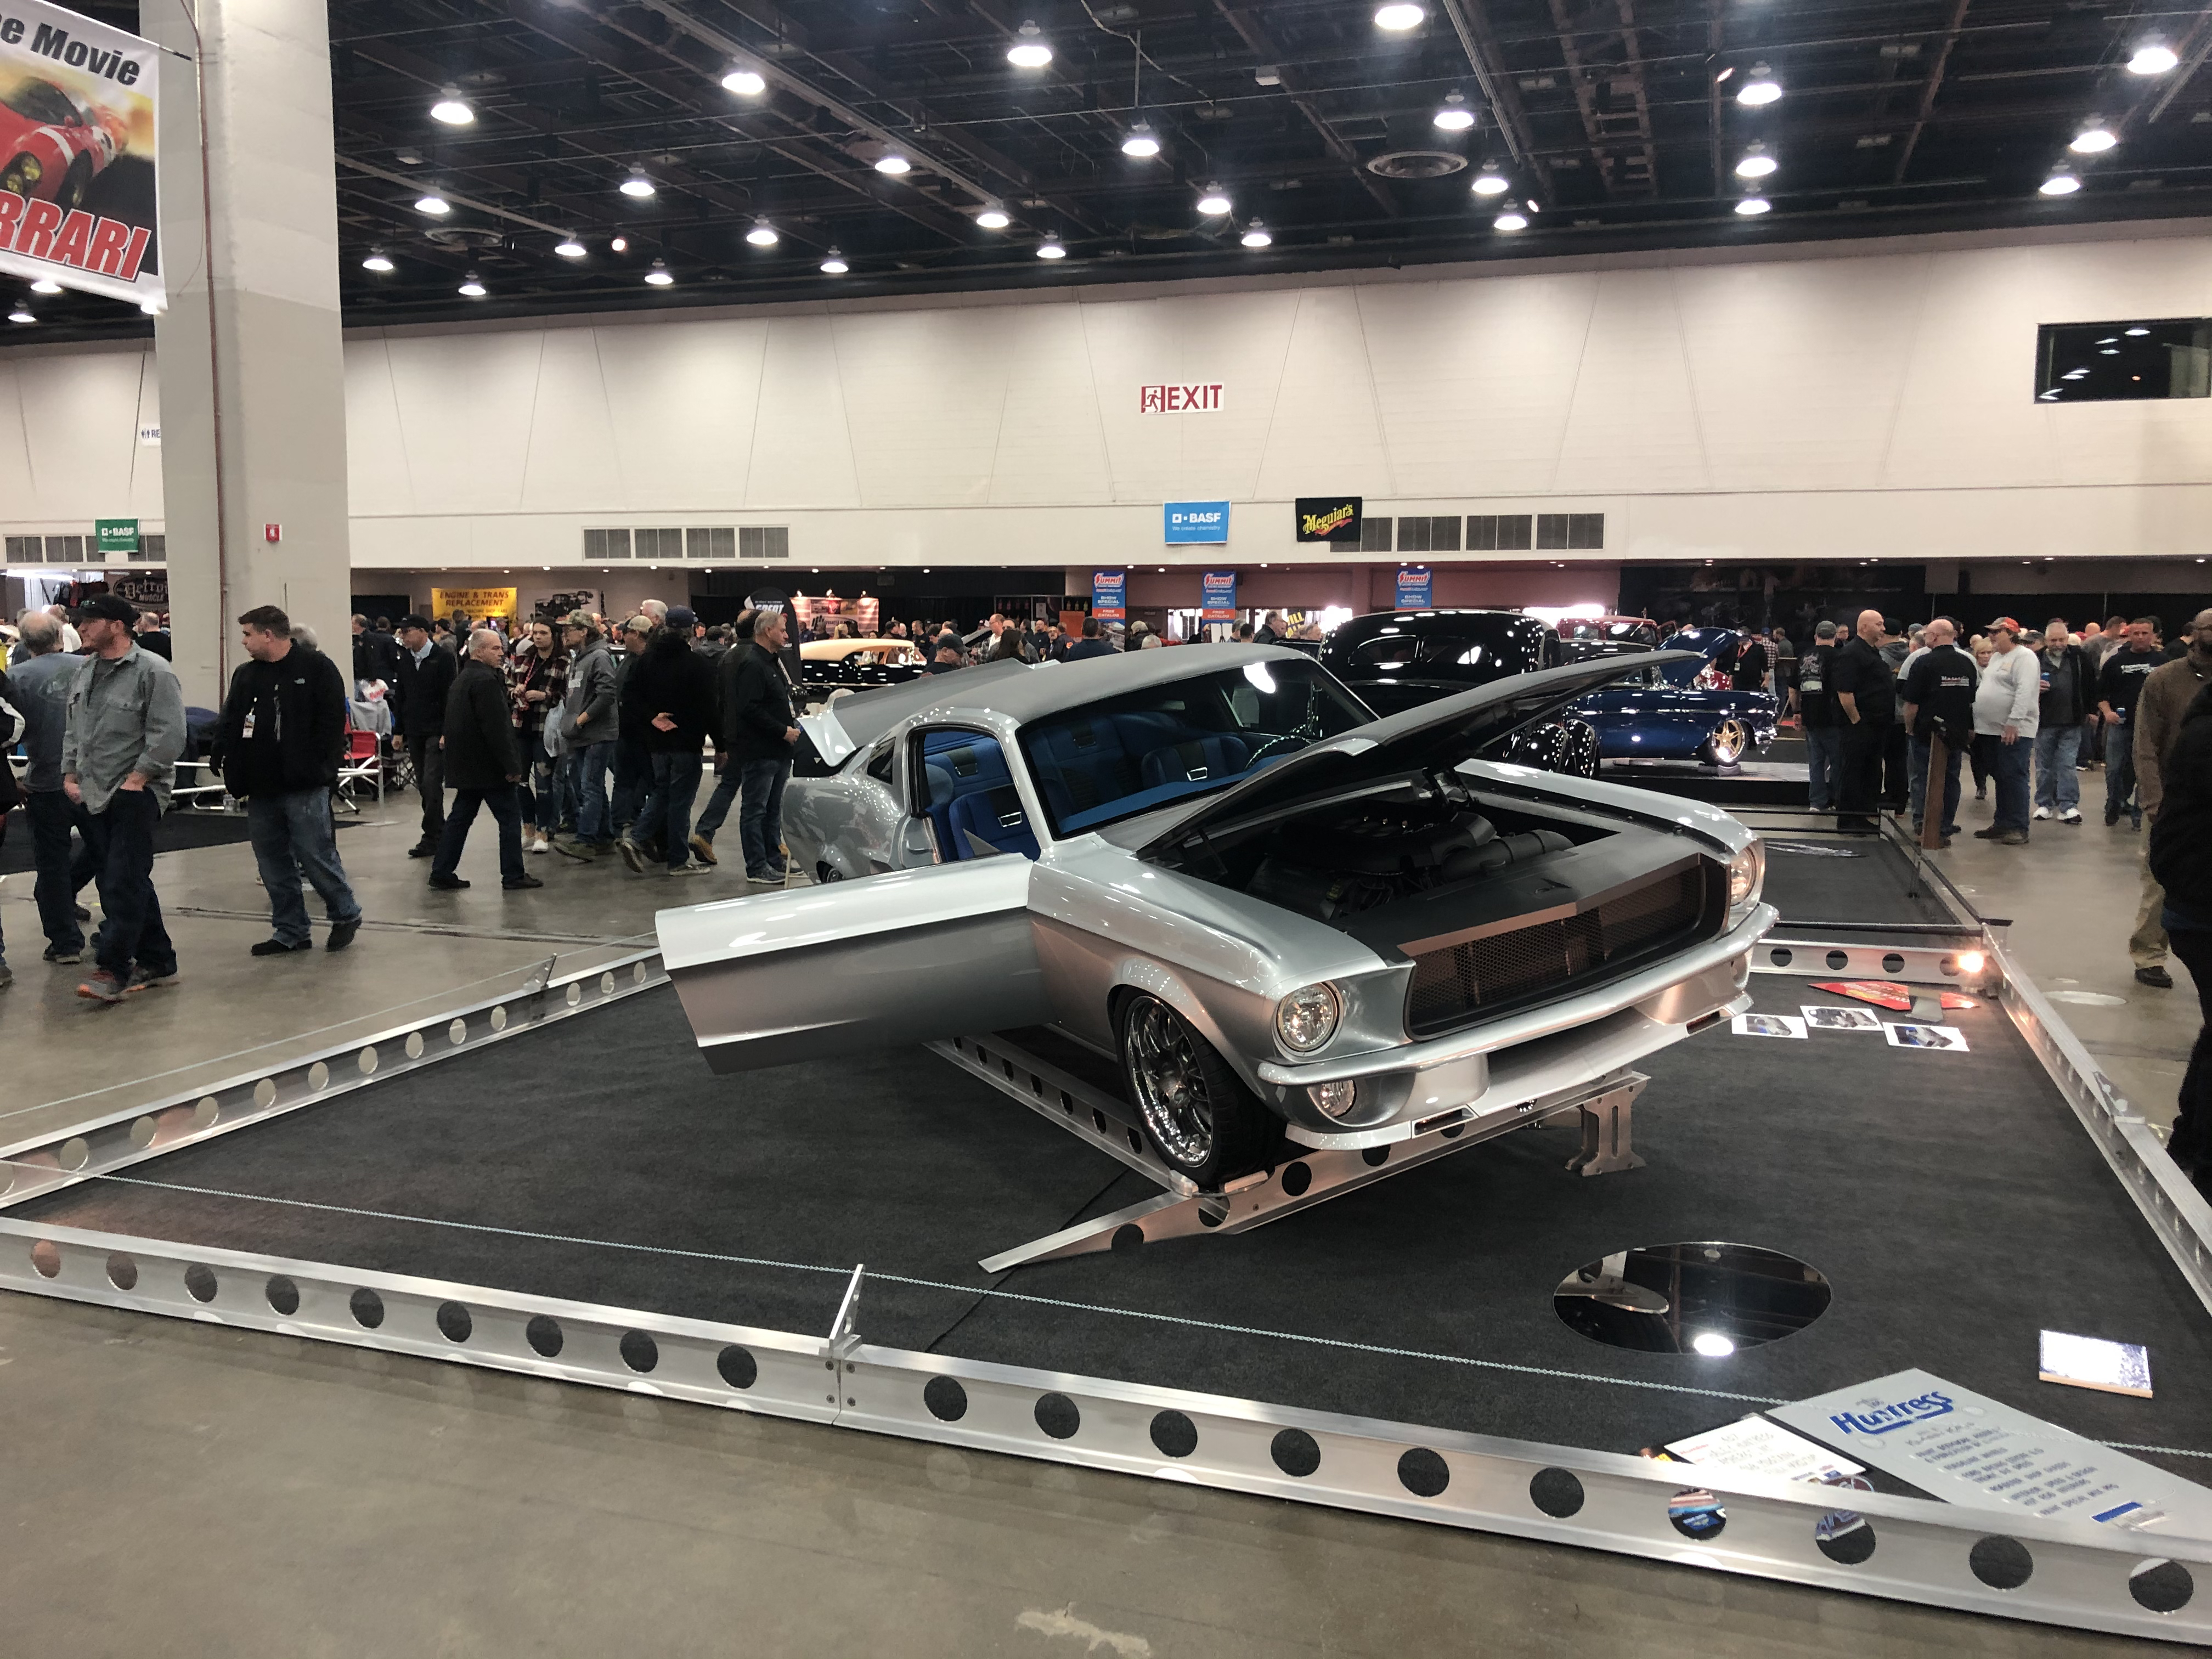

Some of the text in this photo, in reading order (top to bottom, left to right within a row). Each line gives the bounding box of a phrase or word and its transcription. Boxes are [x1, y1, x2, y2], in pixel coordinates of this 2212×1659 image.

[0, 14, 140, 86] e Movie
[1167, 385, 1223, 410] EXIT
[1189, 512, 1221, 523] BASF
[1302, 504, 1353, 534] Meguiar's
[112, 527, 134, 536] BASF
[1829, 1391, 1954, 1435] Huntress
